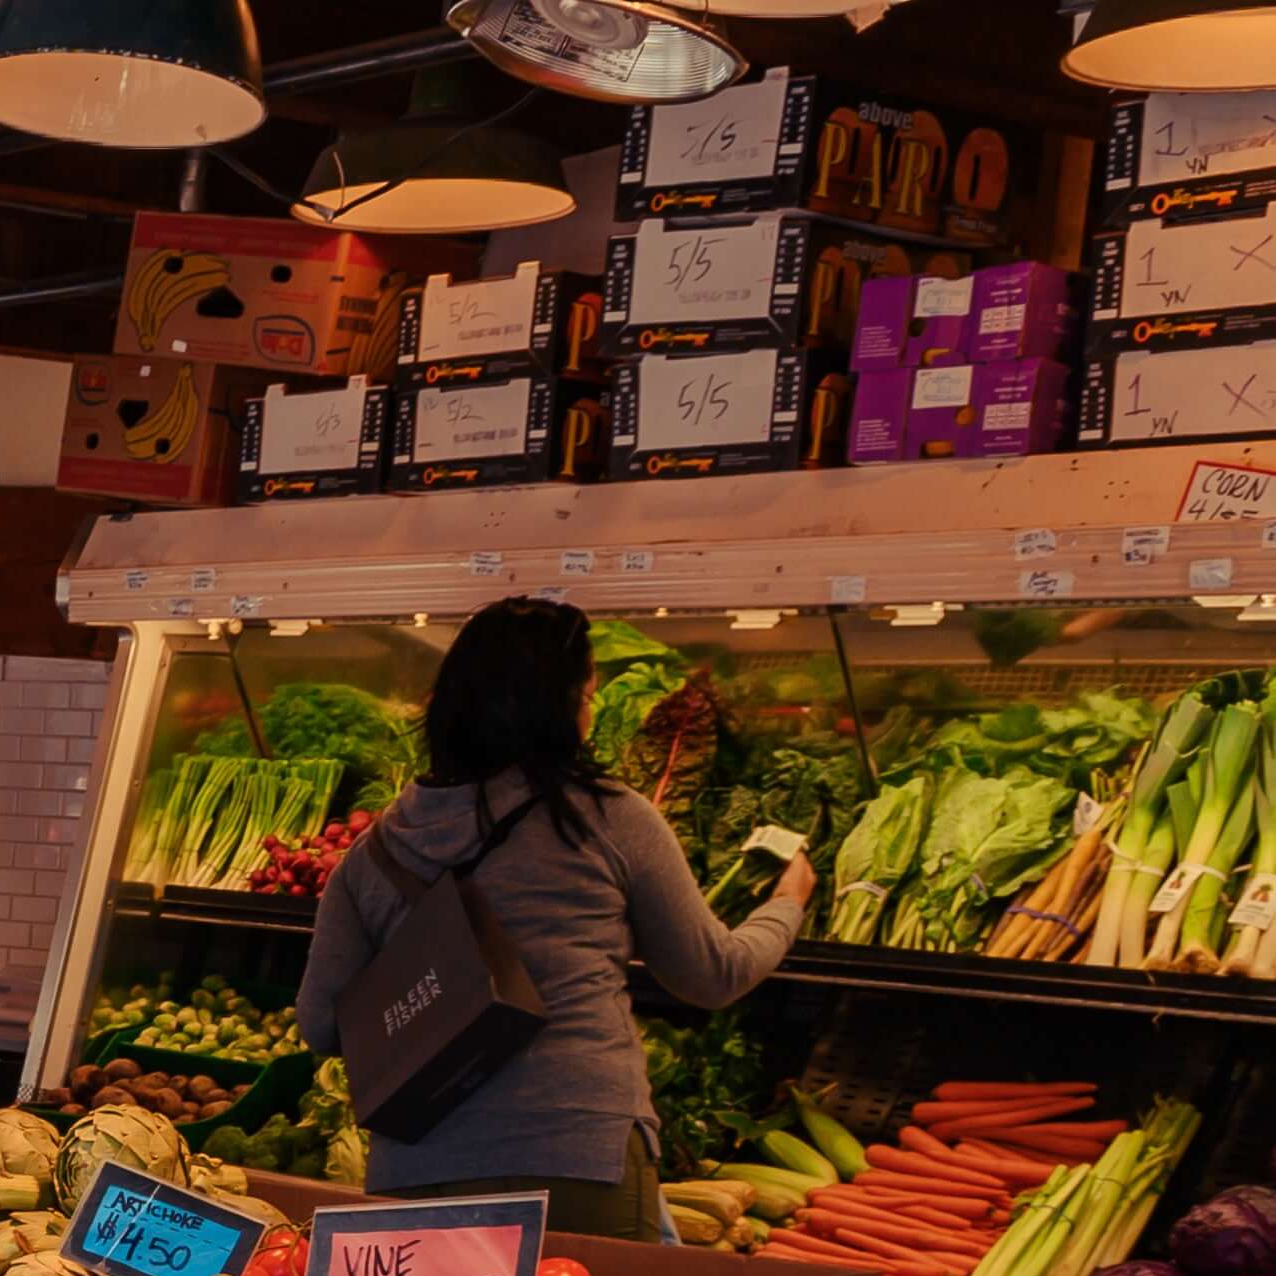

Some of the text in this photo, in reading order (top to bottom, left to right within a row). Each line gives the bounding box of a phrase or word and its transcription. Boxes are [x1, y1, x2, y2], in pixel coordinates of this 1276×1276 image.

[1202, 469, 1270, 502] CORN
[383, 966, 438, 1025] EILEEN
[386, 982, 443, 1038] FISHER
[111, 1191, 205, 1231] ARTICHOKE
[93, 1212, 193, 1273] $4.50
